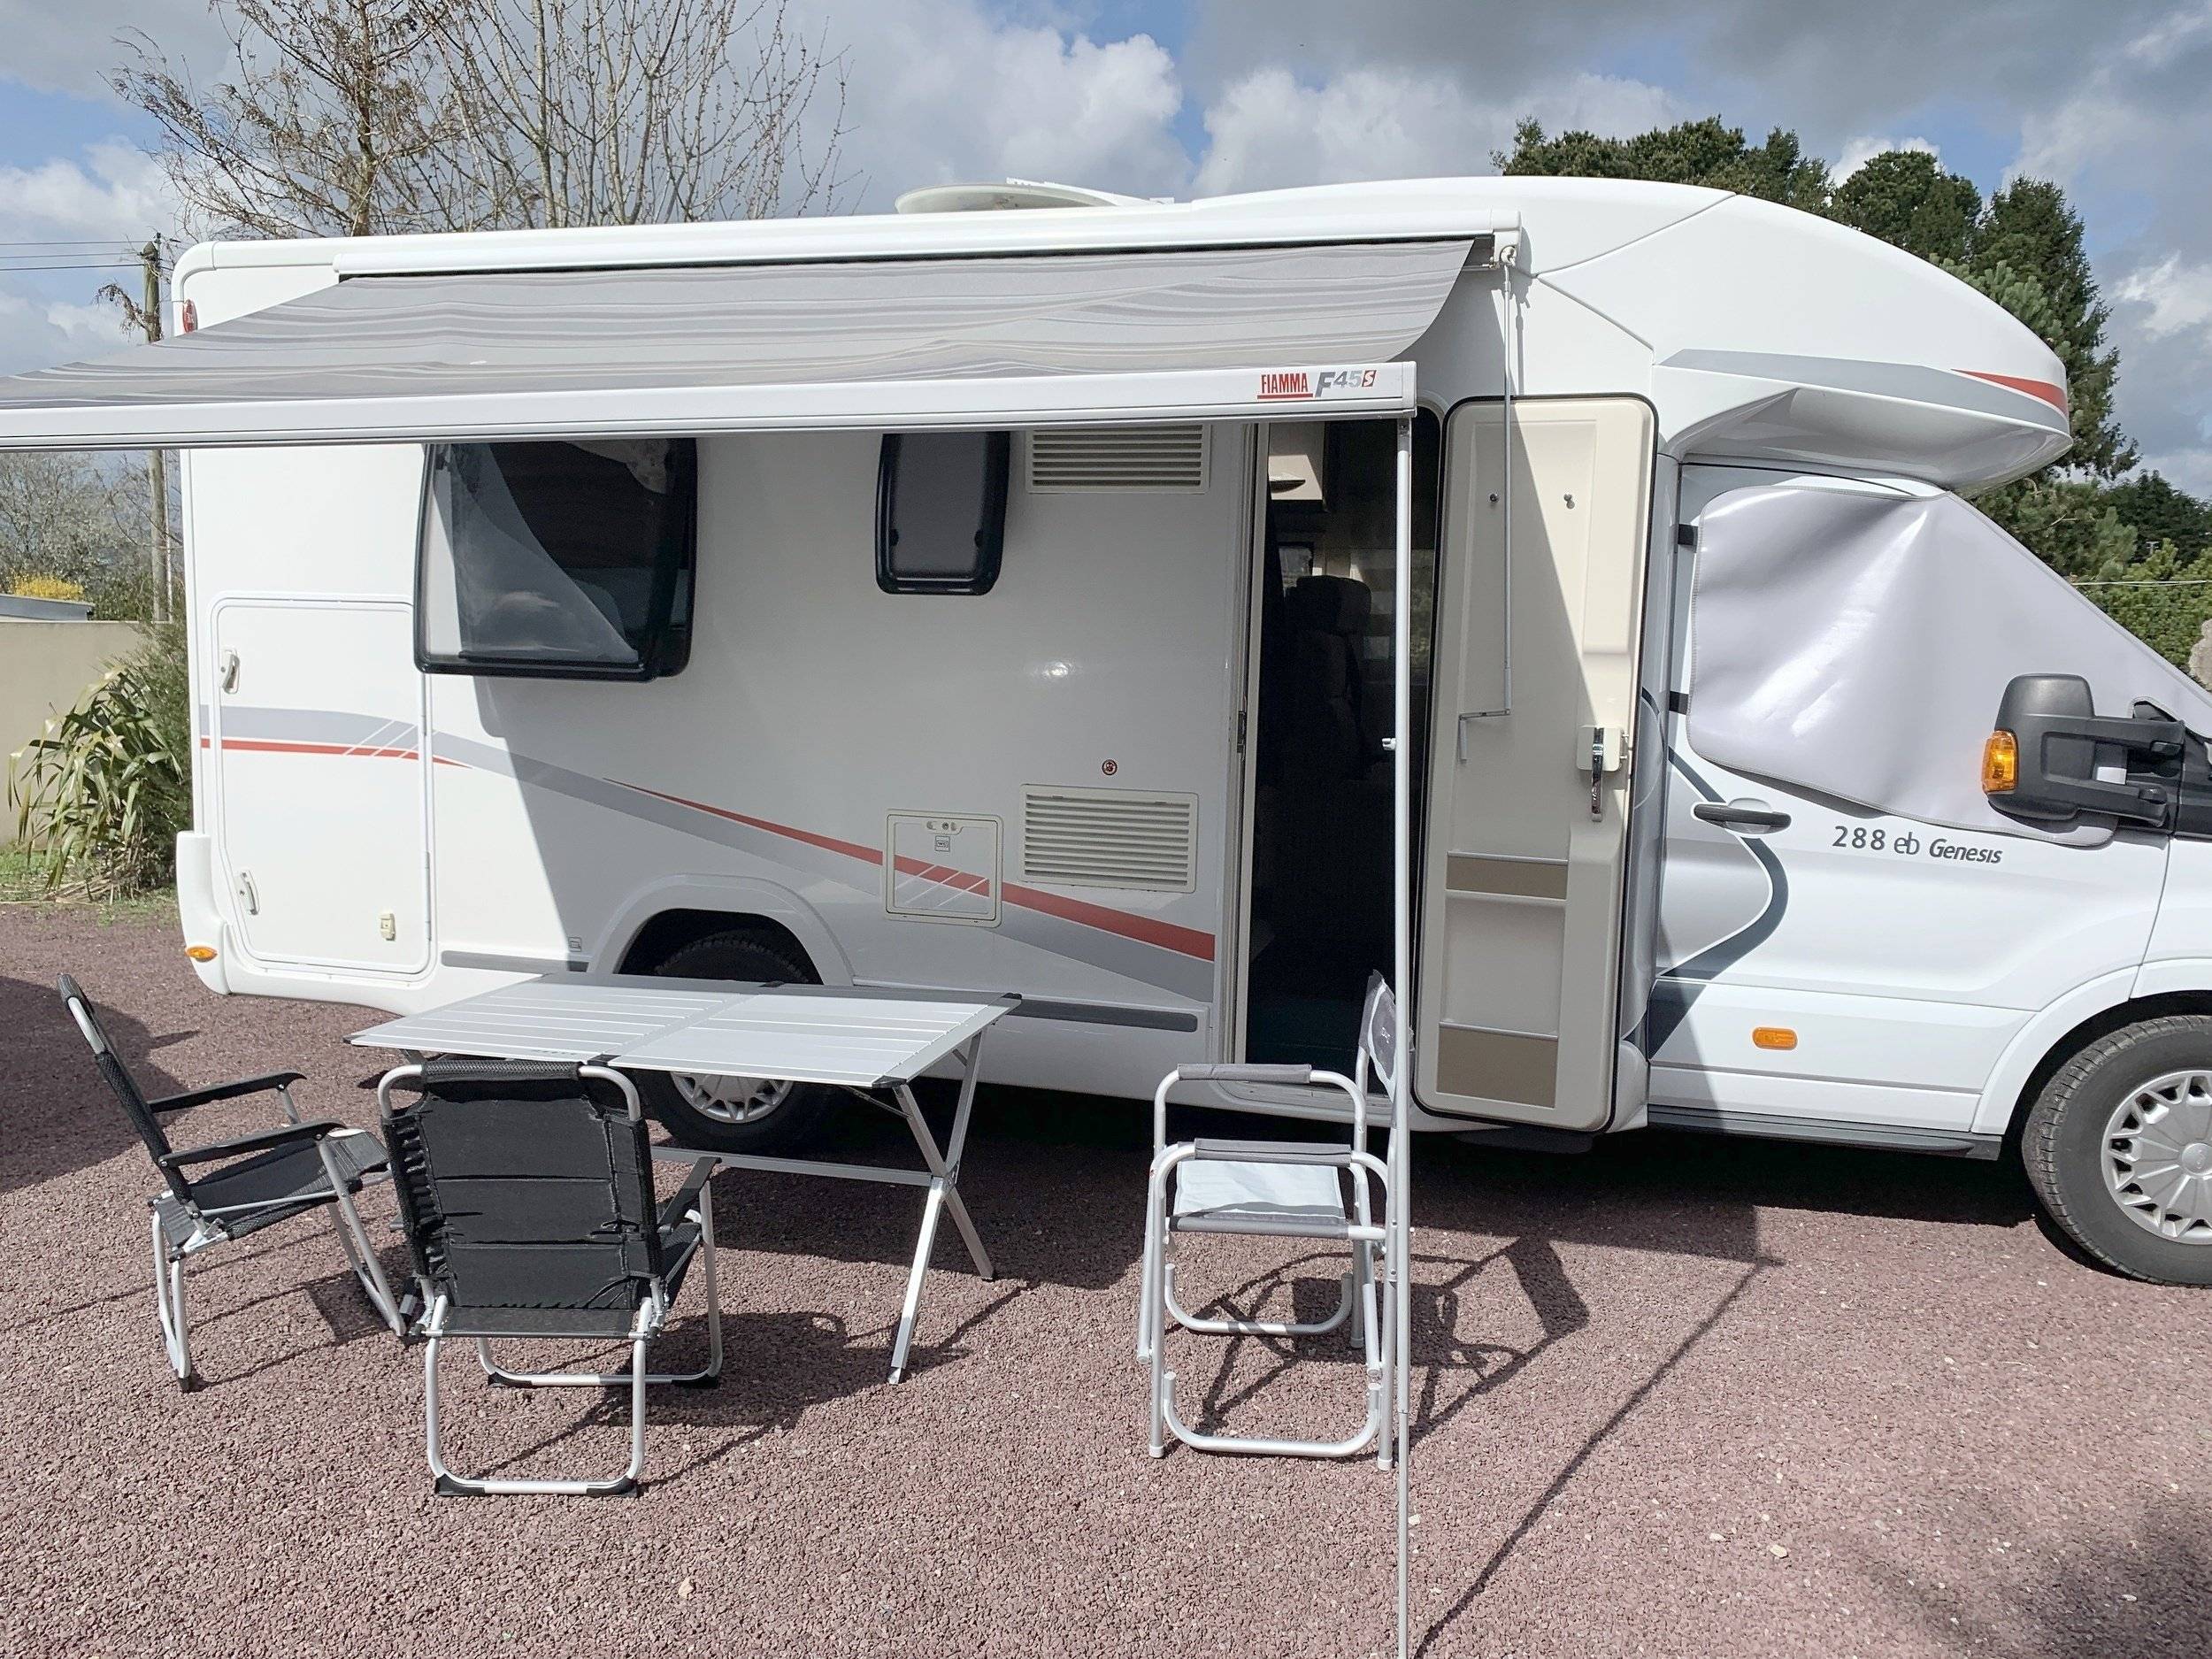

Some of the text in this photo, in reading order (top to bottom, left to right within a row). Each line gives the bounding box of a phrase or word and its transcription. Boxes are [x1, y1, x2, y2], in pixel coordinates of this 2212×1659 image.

[1261, 370, 1377, 398] FIAMMA F45S
[1832, 826, 2003, 864] 288 eb Genesis
